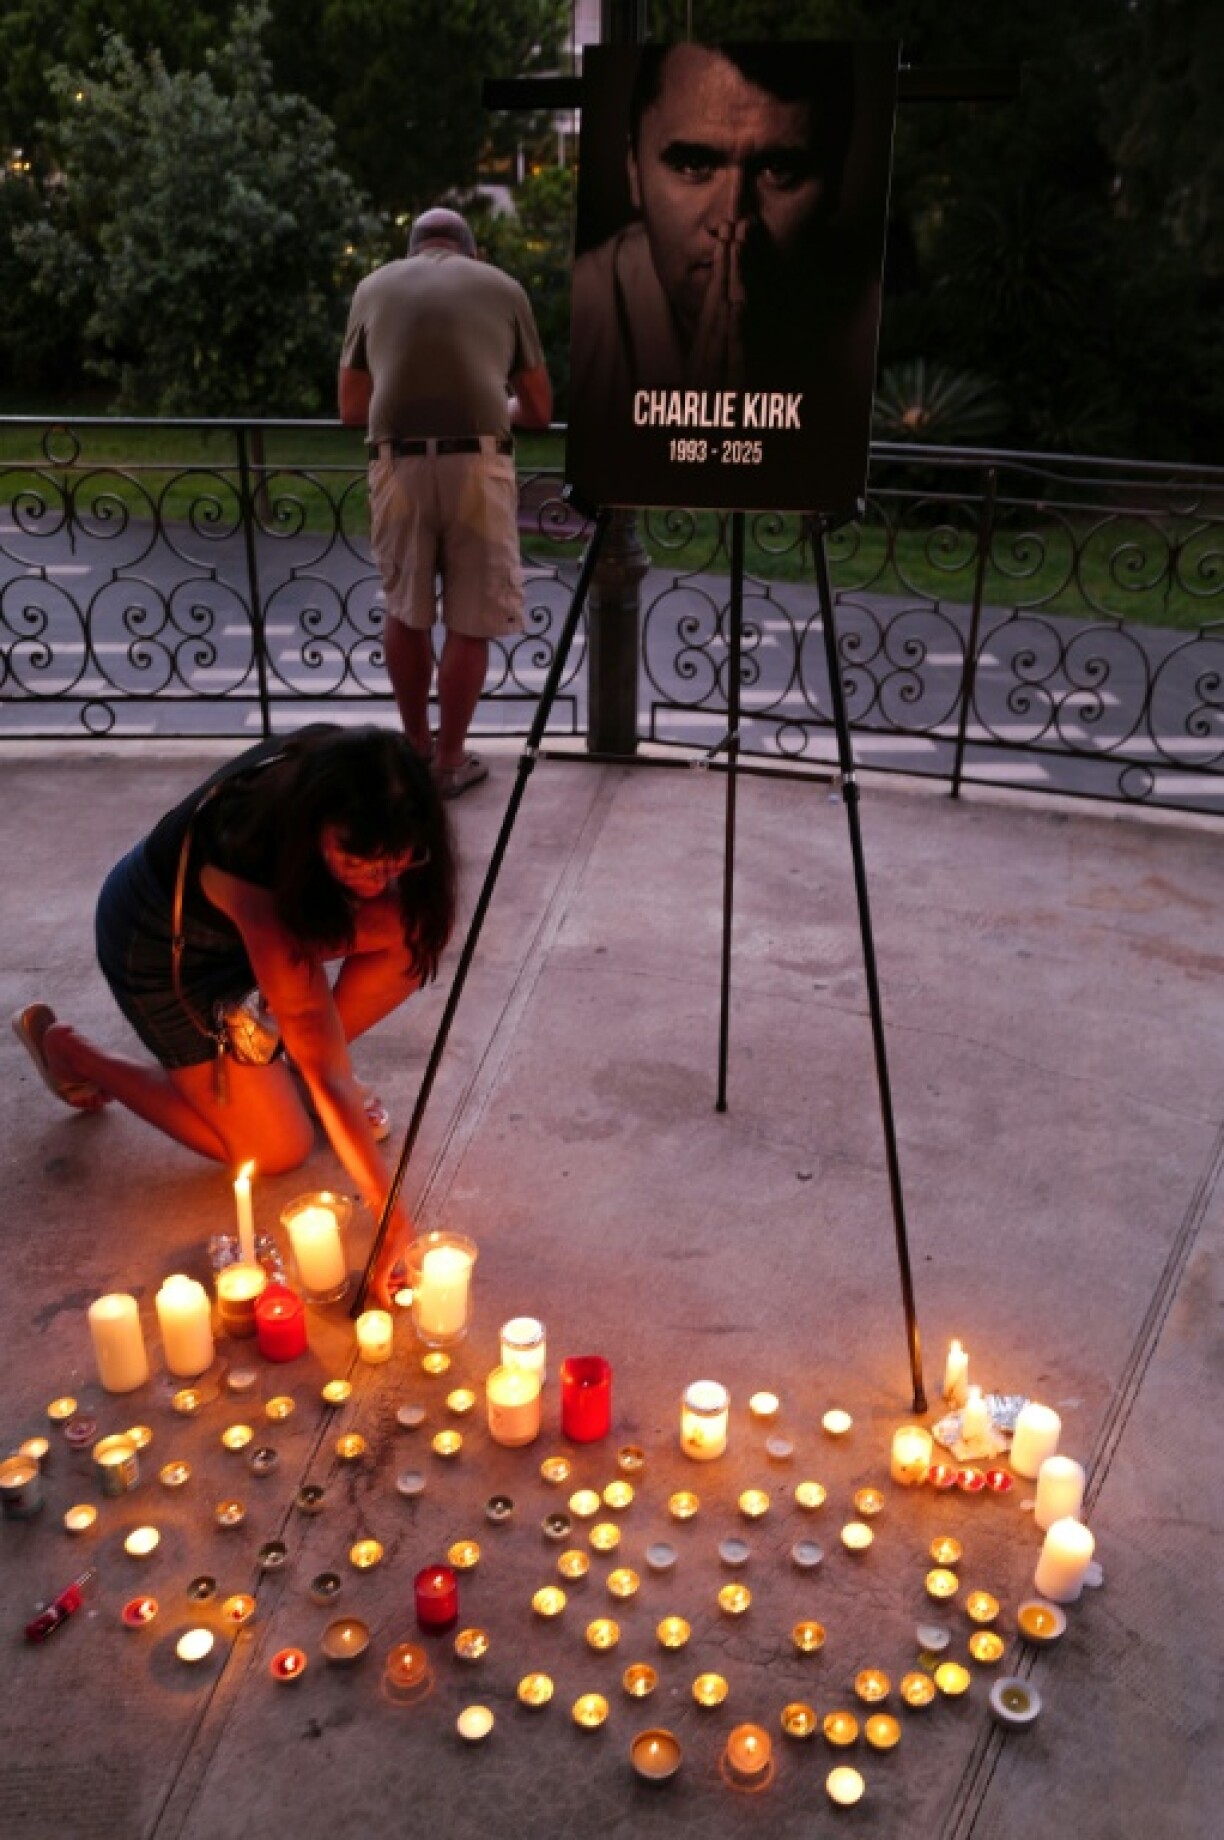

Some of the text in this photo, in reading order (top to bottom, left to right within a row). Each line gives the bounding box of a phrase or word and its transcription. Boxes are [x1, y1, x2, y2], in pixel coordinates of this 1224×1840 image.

[633, 390, 803, 429] CHARLIE KIRK
[670, 439, 708, 462] 1993
[722, 440, 763, 464] 2025
